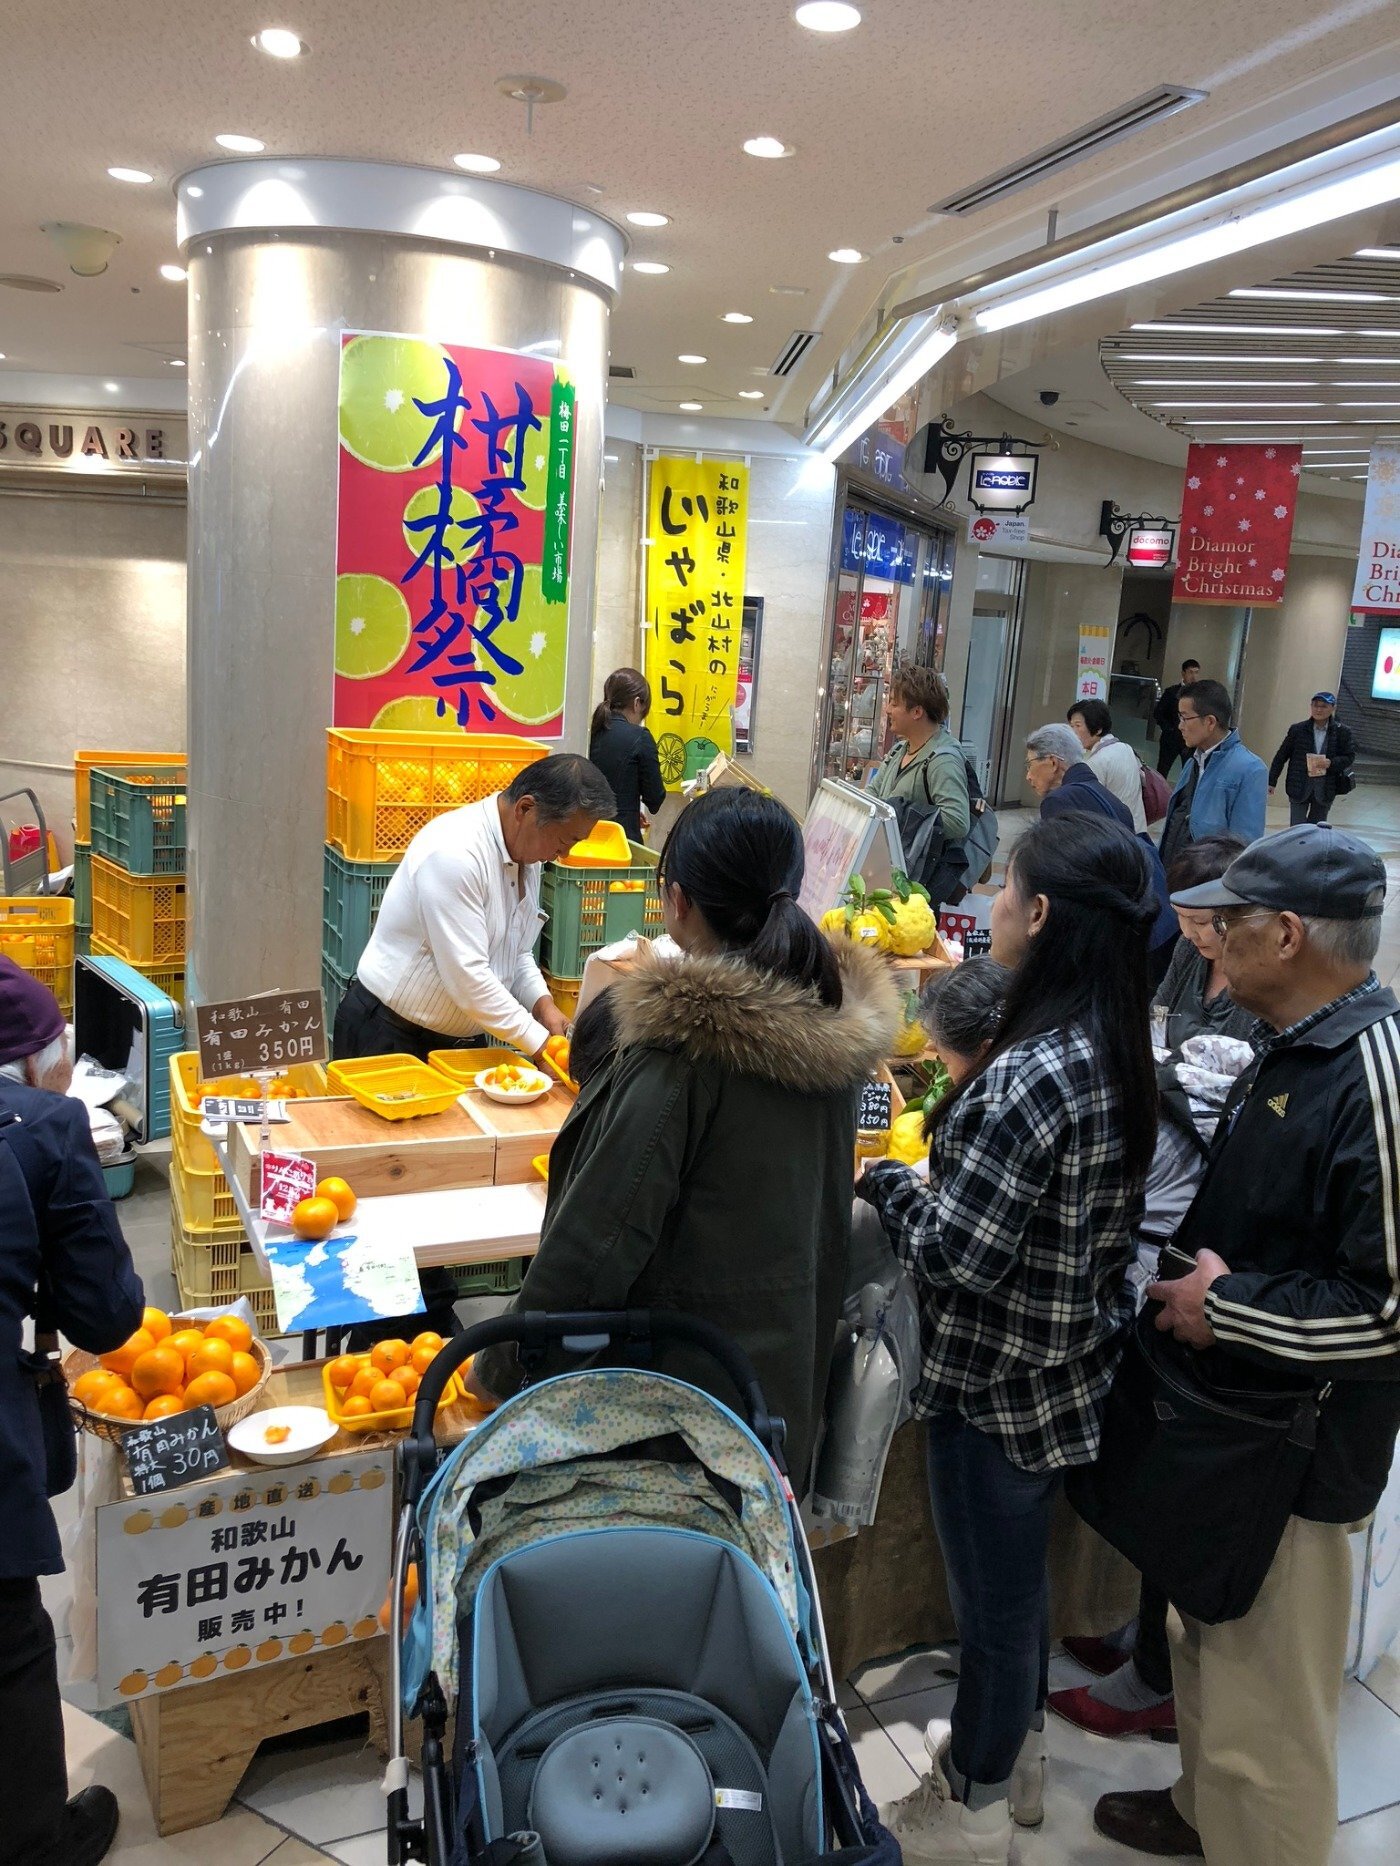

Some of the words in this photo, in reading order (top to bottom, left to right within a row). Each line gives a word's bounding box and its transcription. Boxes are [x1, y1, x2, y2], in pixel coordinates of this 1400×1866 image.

[557, 400, 572, 480] 梅田一丁目
[401, 357, 542, 727] 柑橘祭
[1190, 536, 1255, 554] Diamor
[1187, 556, 1243, 579] Bright
[1185, 576, 1274, 597] Christmas
[661, 486, 709, 716] じゃばら
[1082, 681, 1098, 695] 本日
[210, 1006, 259, 1025] 和歌山
[279, 1000, 310, 1015] 有田
[202, 1016, 321, 1046] 有田みかん
[259, 1035, 314, 1062] 350円
[211, 1058, 245, 1072] (1kg)
[1267, 1099, 1286, 1118] adidas
[126, 1425, 167, 1447] 和歌山
[132, 1418, 219, 1462] 有田みかん
[172, 1447, 220, 1475] 30円
[142, 1472, 167, 1493] 1個
[199, 1481, 315, 1518] 産地直送
[210, 1516, 296, 1553] 和歌山
[136, 1538, 363, 1618] 有田みかん
[197, 1599, 304, 1643] 販売中!
